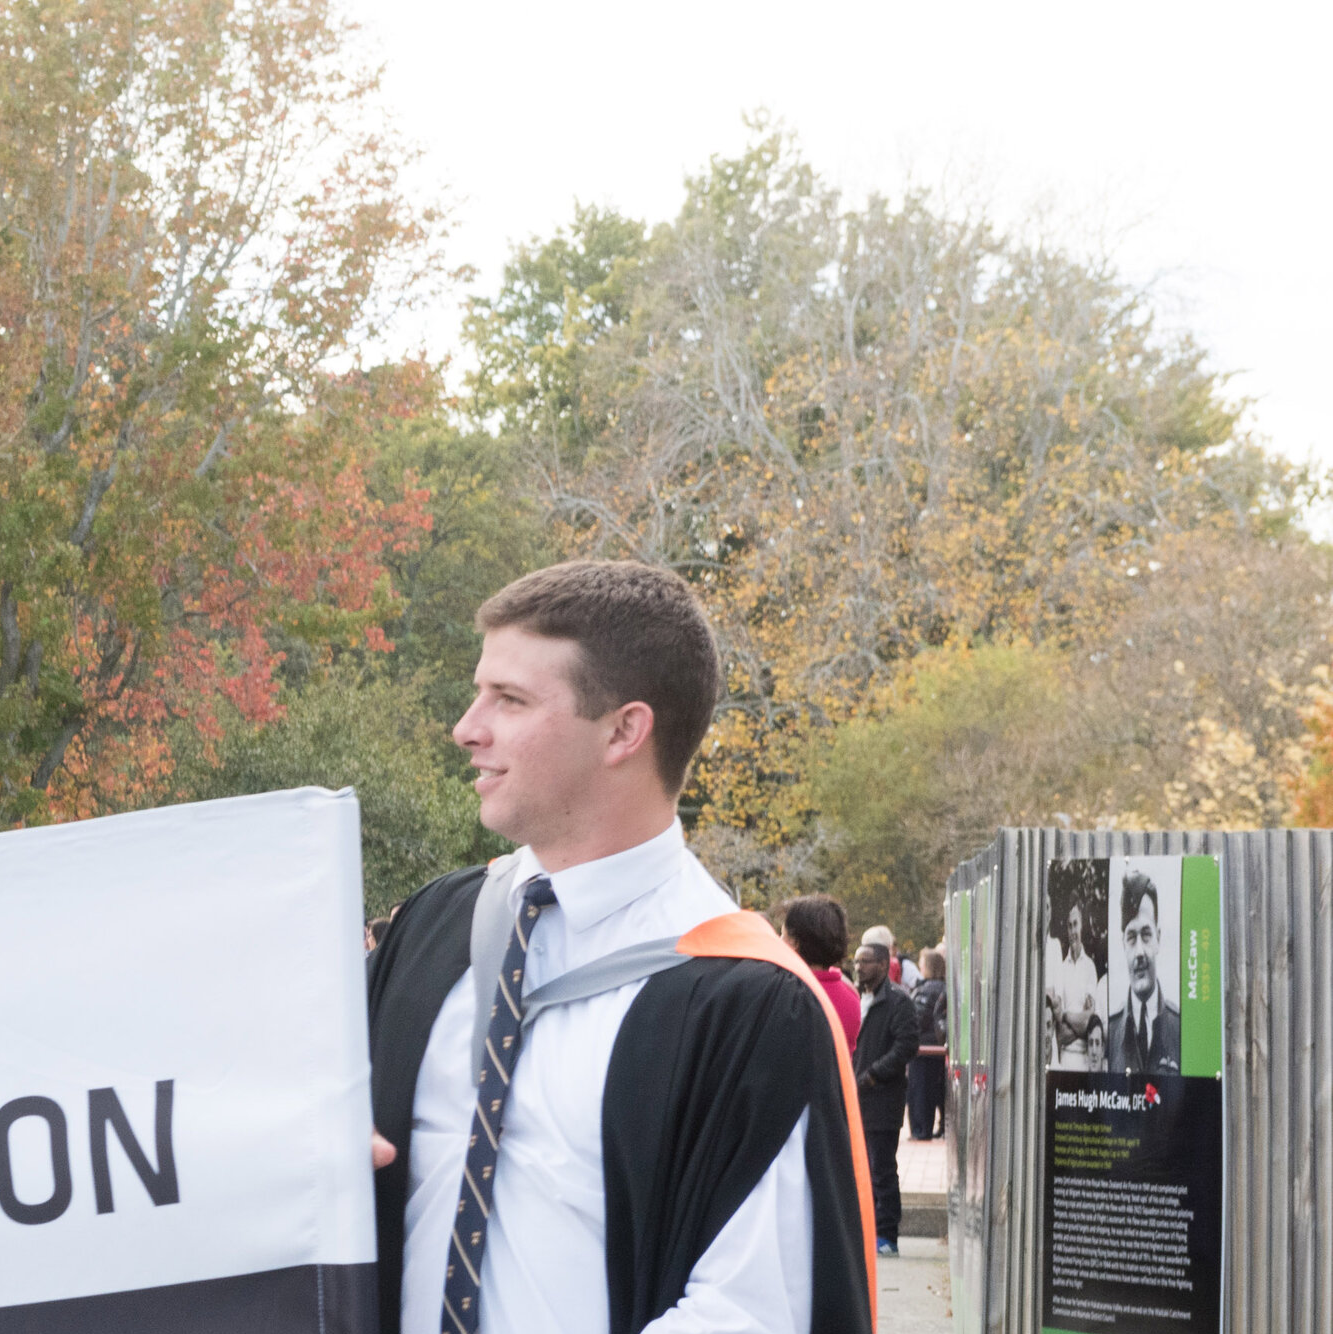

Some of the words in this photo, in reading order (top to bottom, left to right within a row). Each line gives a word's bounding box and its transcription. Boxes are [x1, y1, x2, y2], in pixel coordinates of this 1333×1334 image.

[1188, 929, 1197, 999] McCaw
[1055, 1088, 1077, 1110] James
[1078, 1089, 1098, 1113] Hugh
[1099, 1090, 1131, 1113] McCaw,
[1132, 1094, 1146, 1112] DFC
